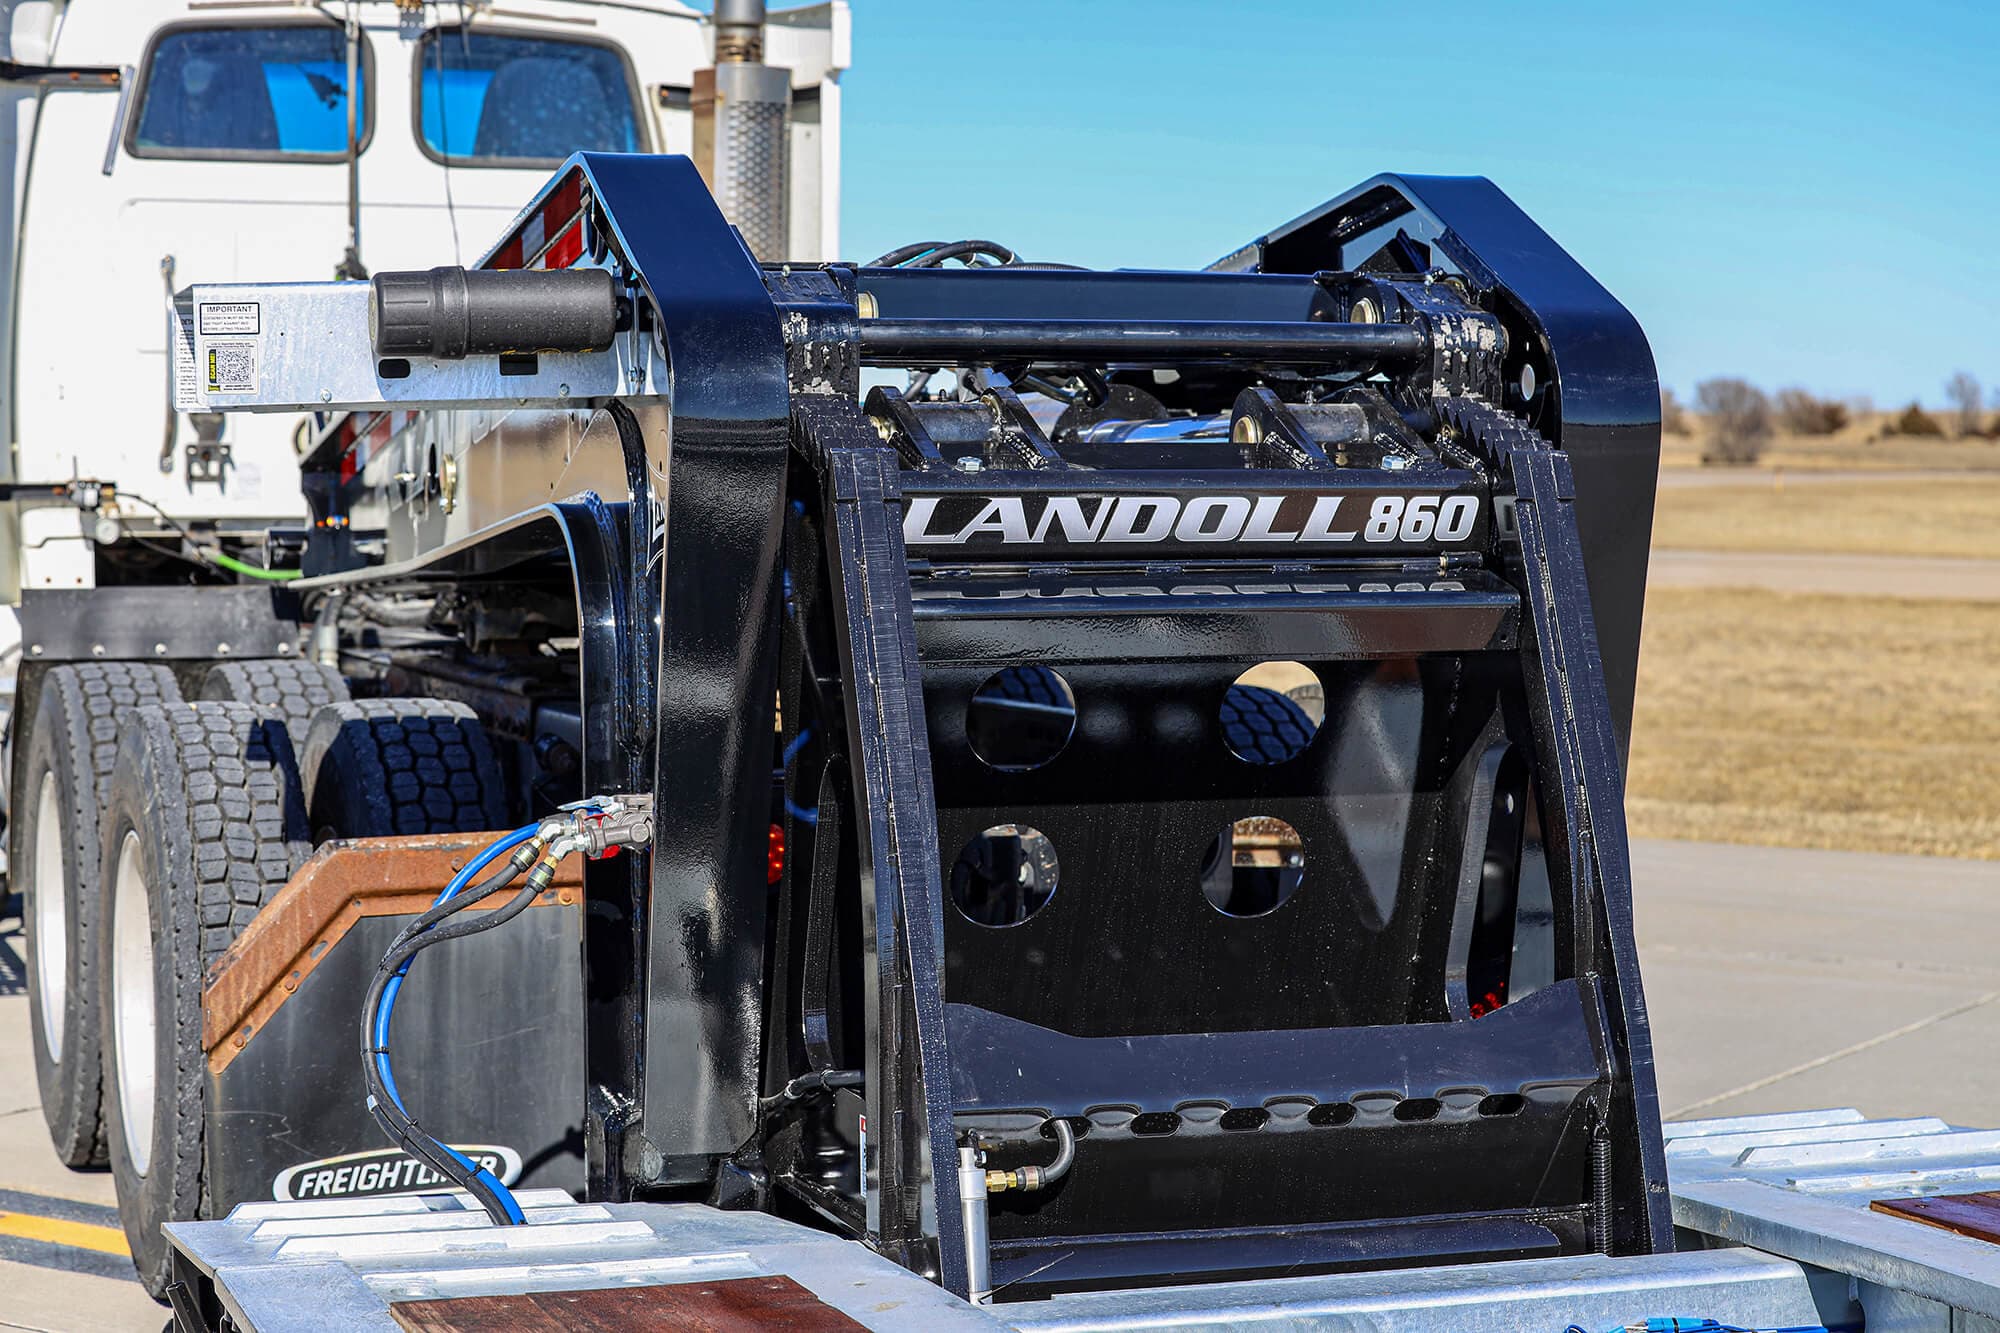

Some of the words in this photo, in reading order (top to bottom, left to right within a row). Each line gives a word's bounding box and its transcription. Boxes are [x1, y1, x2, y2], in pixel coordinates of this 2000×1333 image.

[206, 305, 252, 313] IMPORTANT
[902, 496, 1357, 544] LANDOLL
[1364, 495, 1480, 542] 860
[298, 1155, 498, 1198] FREIGHTLR
